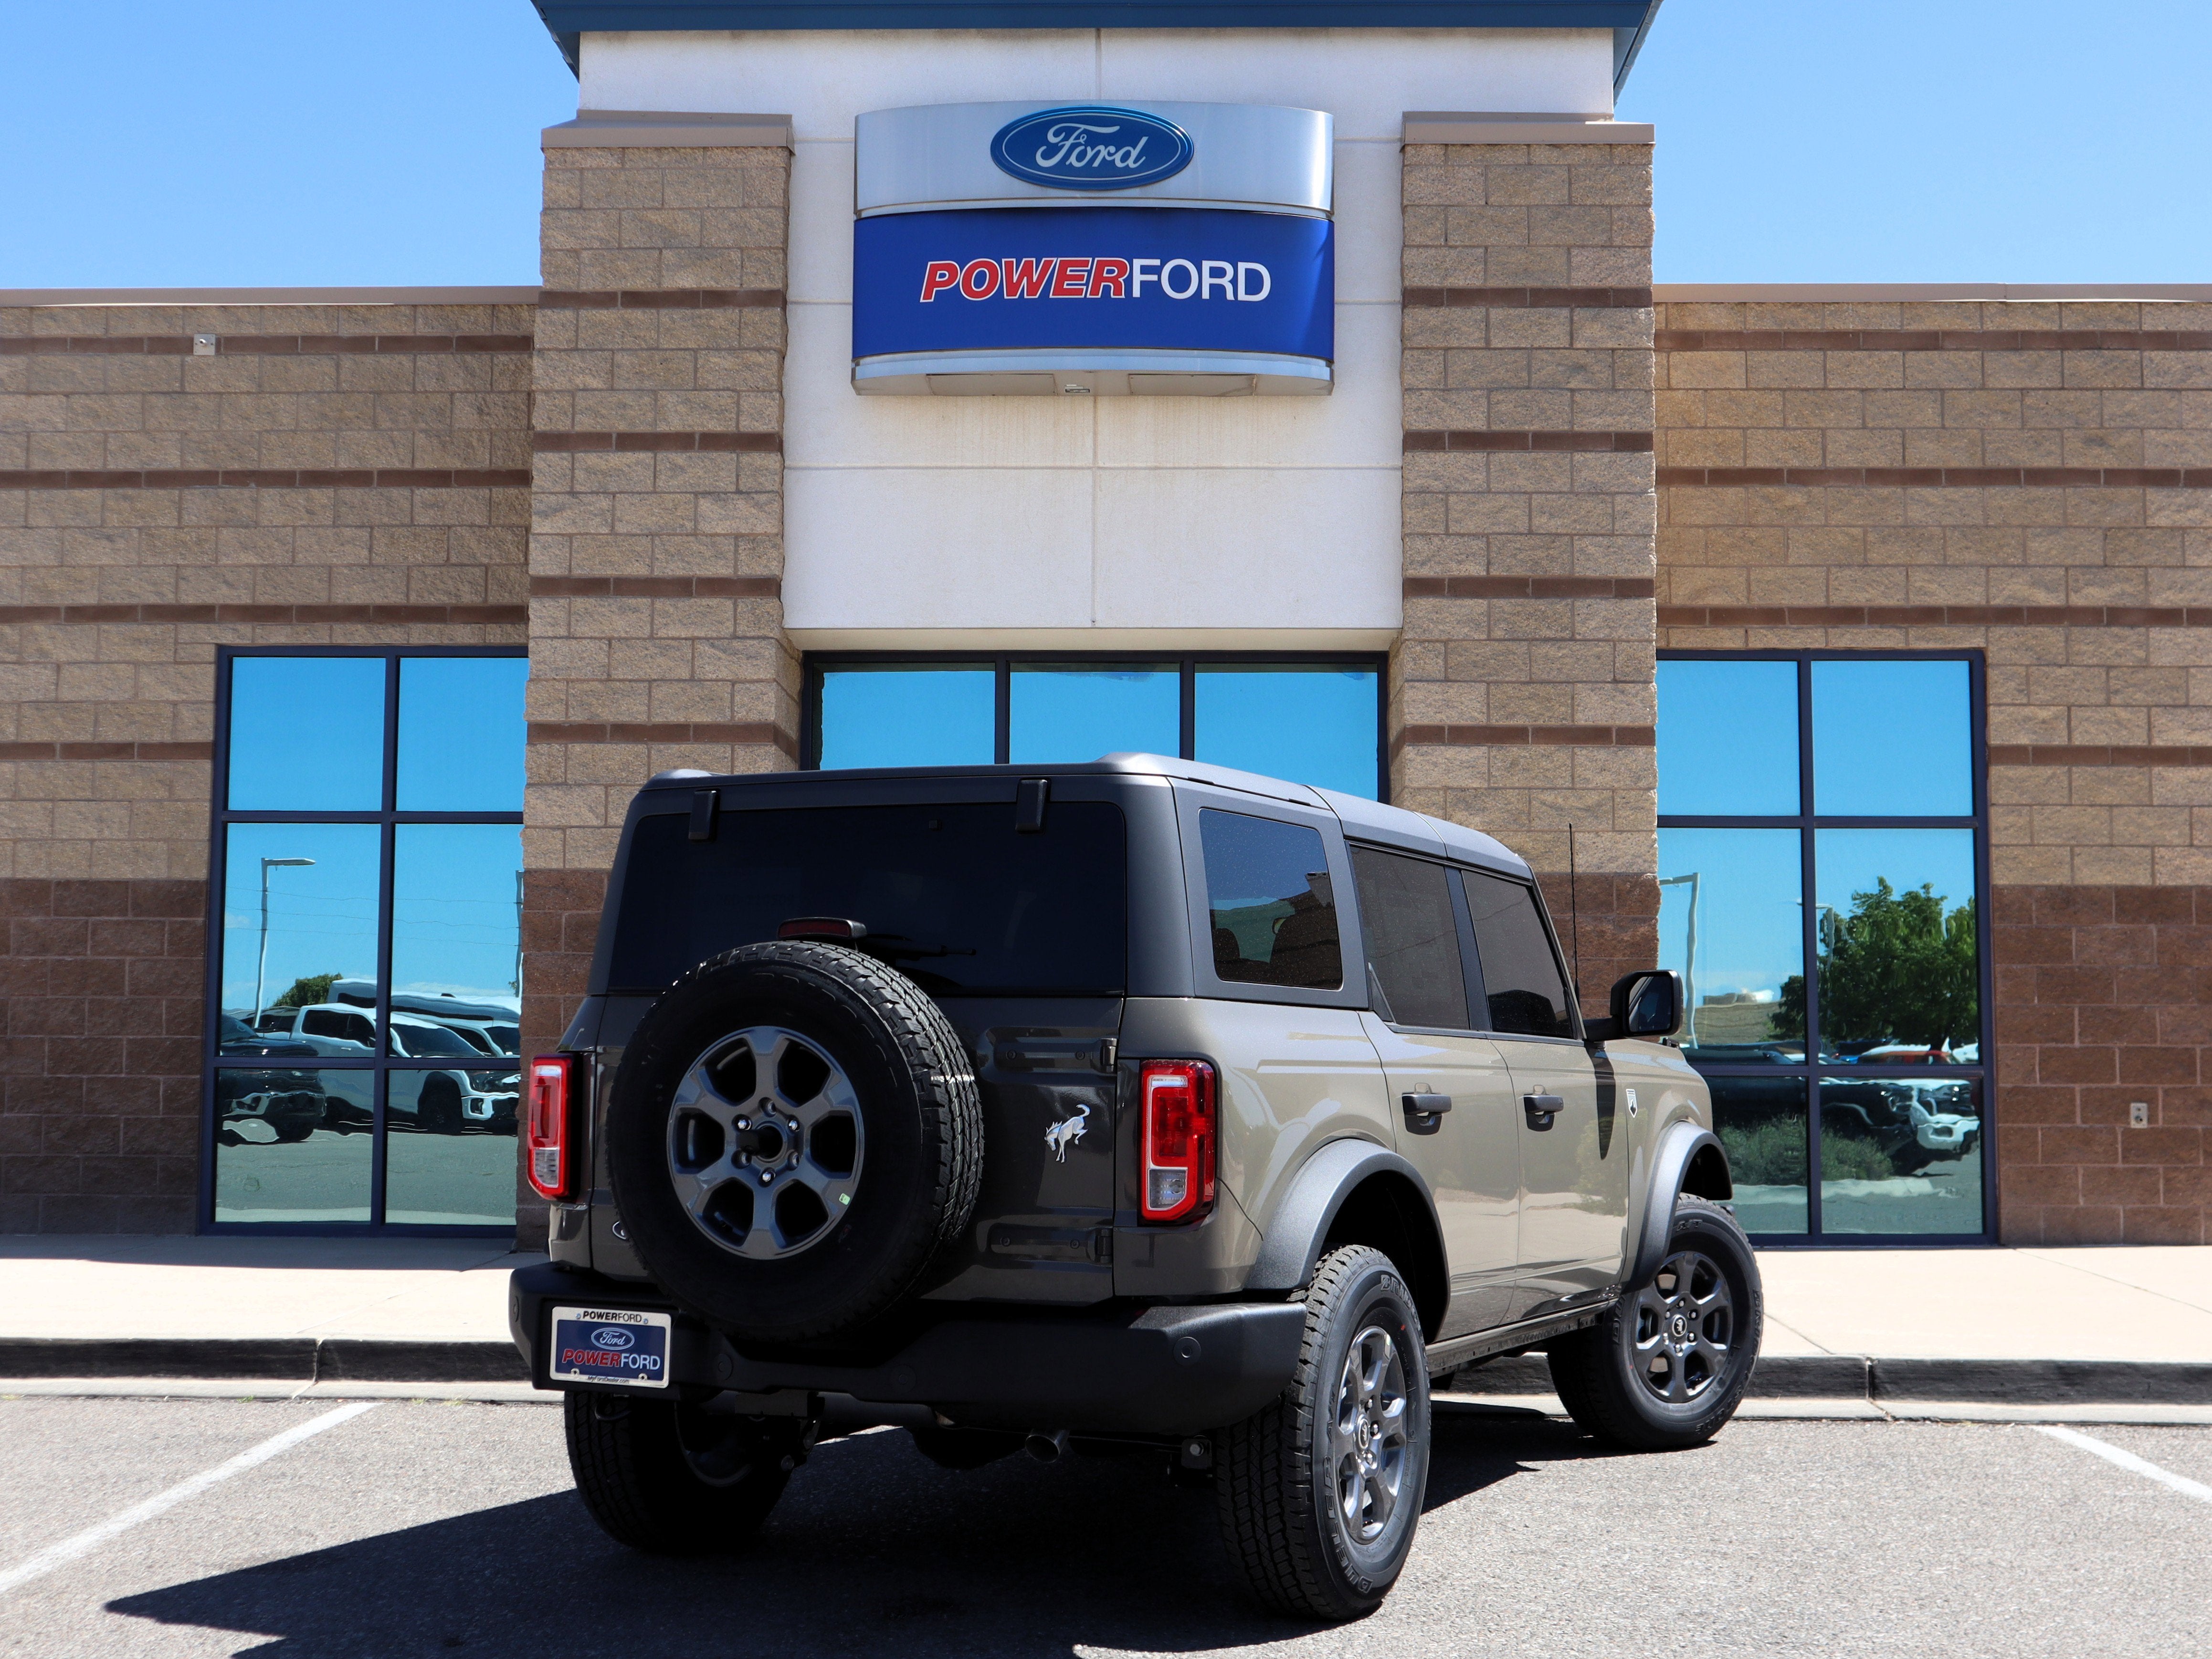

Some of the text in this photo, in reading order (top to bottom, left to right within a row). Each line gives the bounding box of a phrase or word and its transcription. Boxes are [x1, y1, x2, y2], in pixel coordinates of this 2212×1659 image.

[1035, 122, 1149, 169] Ford
[582, 1311, 642, 1323] POWERFORD
[600, 1332, 626, 1345] Ford
[562, 1349, 661, 1370] POWERFORD
